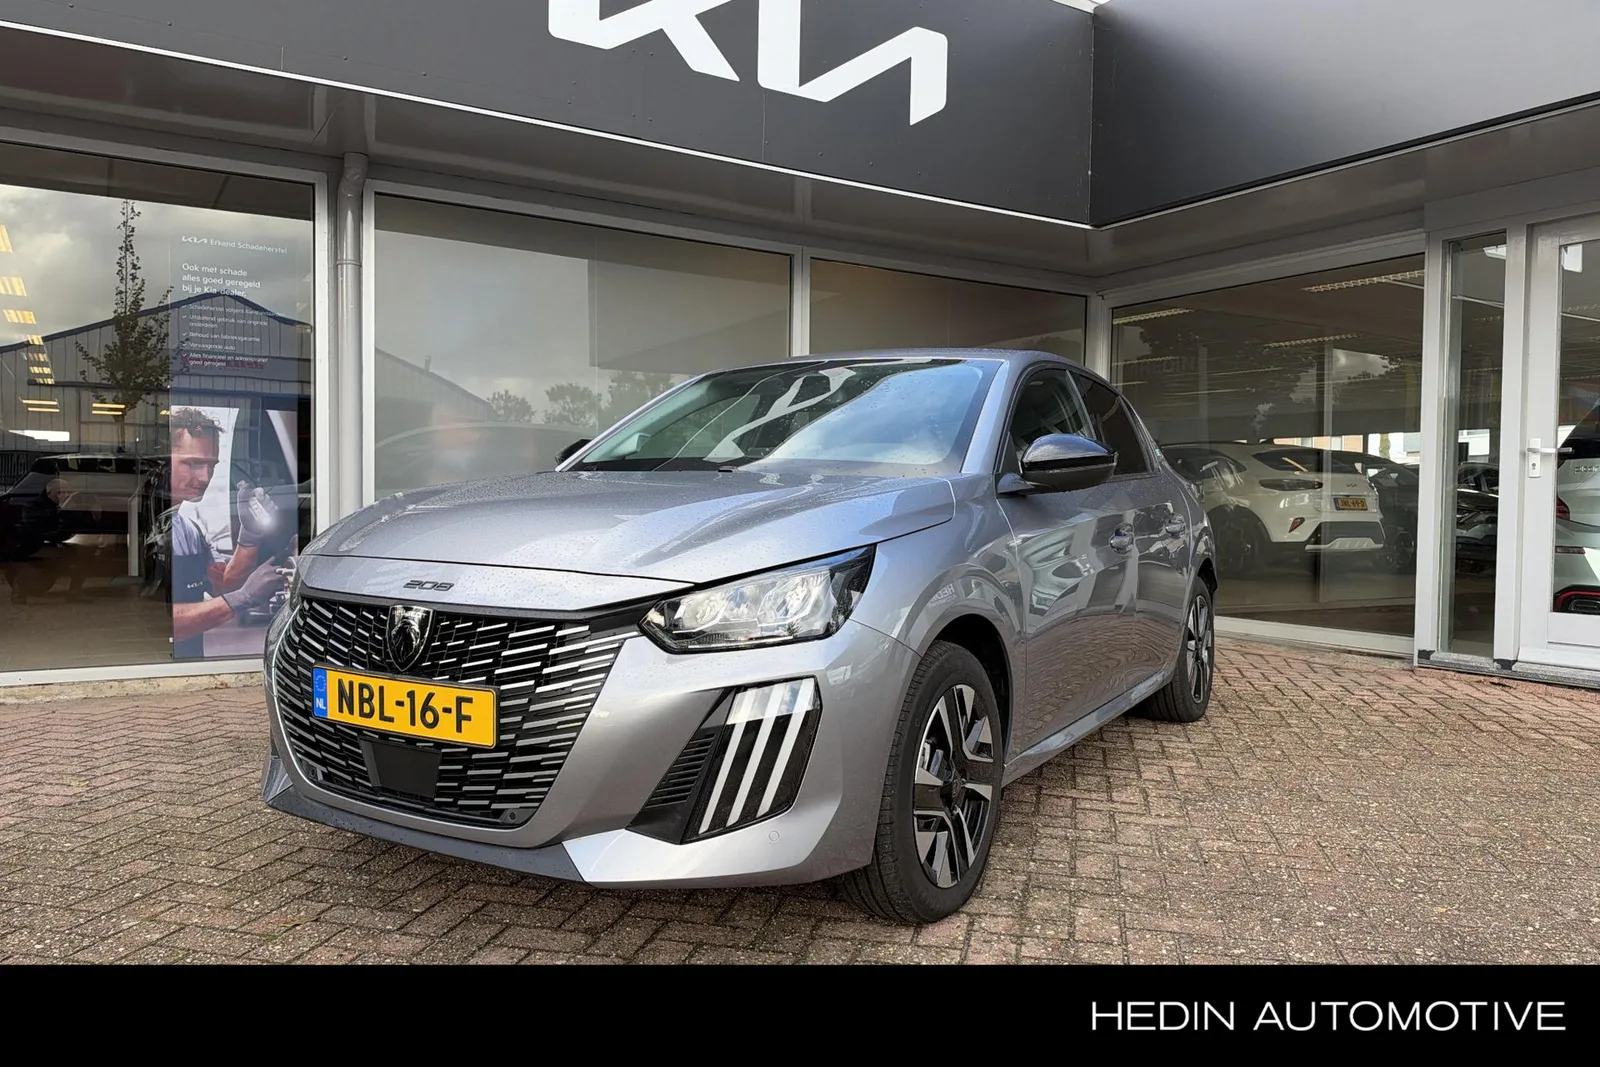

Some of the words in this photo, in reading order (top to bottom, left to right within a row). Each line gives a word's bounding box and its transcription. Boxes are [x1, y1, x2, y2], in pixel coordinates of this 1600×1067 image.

[210, 238, 236, 248] Erkend
[237, 241, 288, 254] Schadeherstel
[182, 262, 200, 272] Ook
[201, 265, 217, 274] met
[219, 267, 248, 277] schade
[182, 273, 201, 283] alles
[202, 275, 224, 286] goed
[225, 278, 261, 289] geregeld
[182, 284, 193, 294] bij
[193, 285, 202, 294] je
[403, 579, 454, 592] 208
[315, 697, 326, 710] NL
[337, 677, 474, 734] NBL-16-F
